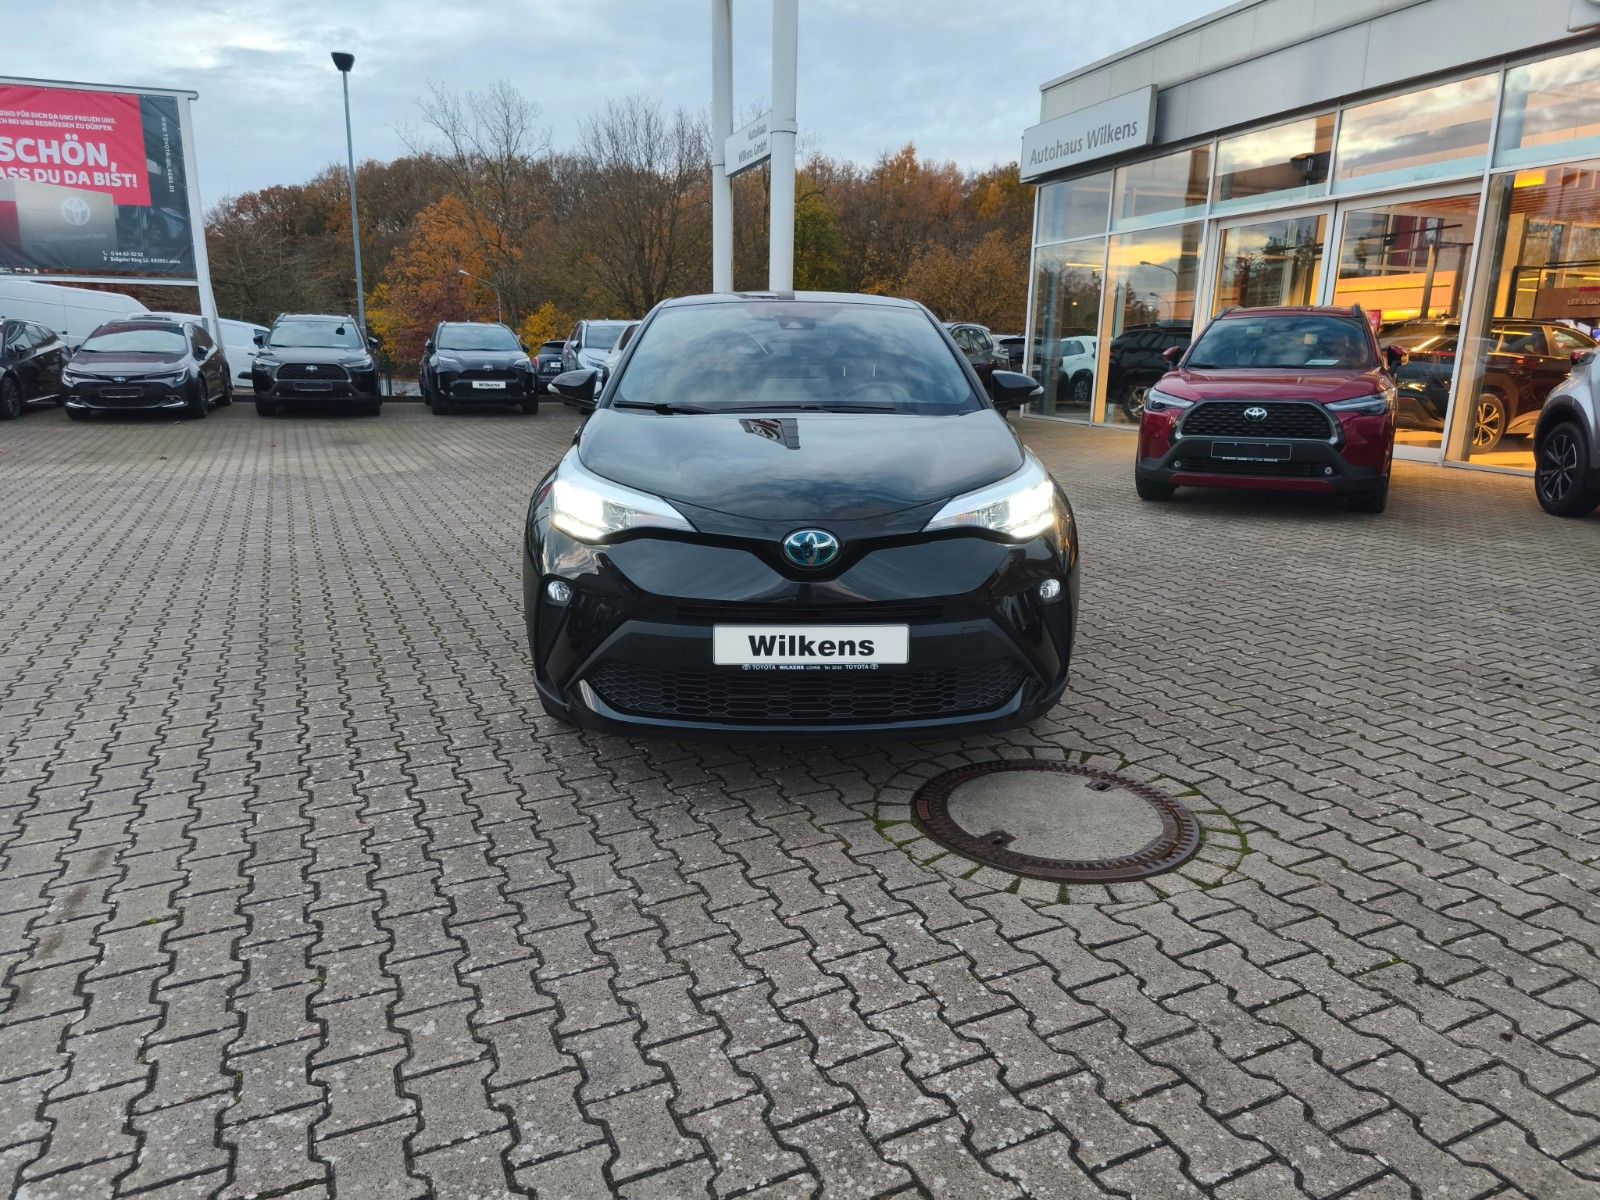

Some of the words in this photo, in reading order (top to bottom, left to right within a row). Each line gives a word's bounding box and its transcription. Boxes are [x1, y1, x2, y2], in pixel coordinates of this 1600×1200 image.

[16, 110, 31, 118] FÜR
[74, 115, 101, 123] FREUEN
[34, 119, 75, 129] BEGRÜSSEN
[0, 133, 117, 173] SCHÖN,
[1029, 138, 1083, 166] Autohaus
[1086, 121, 1138, 149] Wilkens
[33, 168, 60, 184] DU
[63, 170, 91, 185] DA
[93, 171, 138, 188] BIST!
[748, 635, 875, 657] Wilkens
